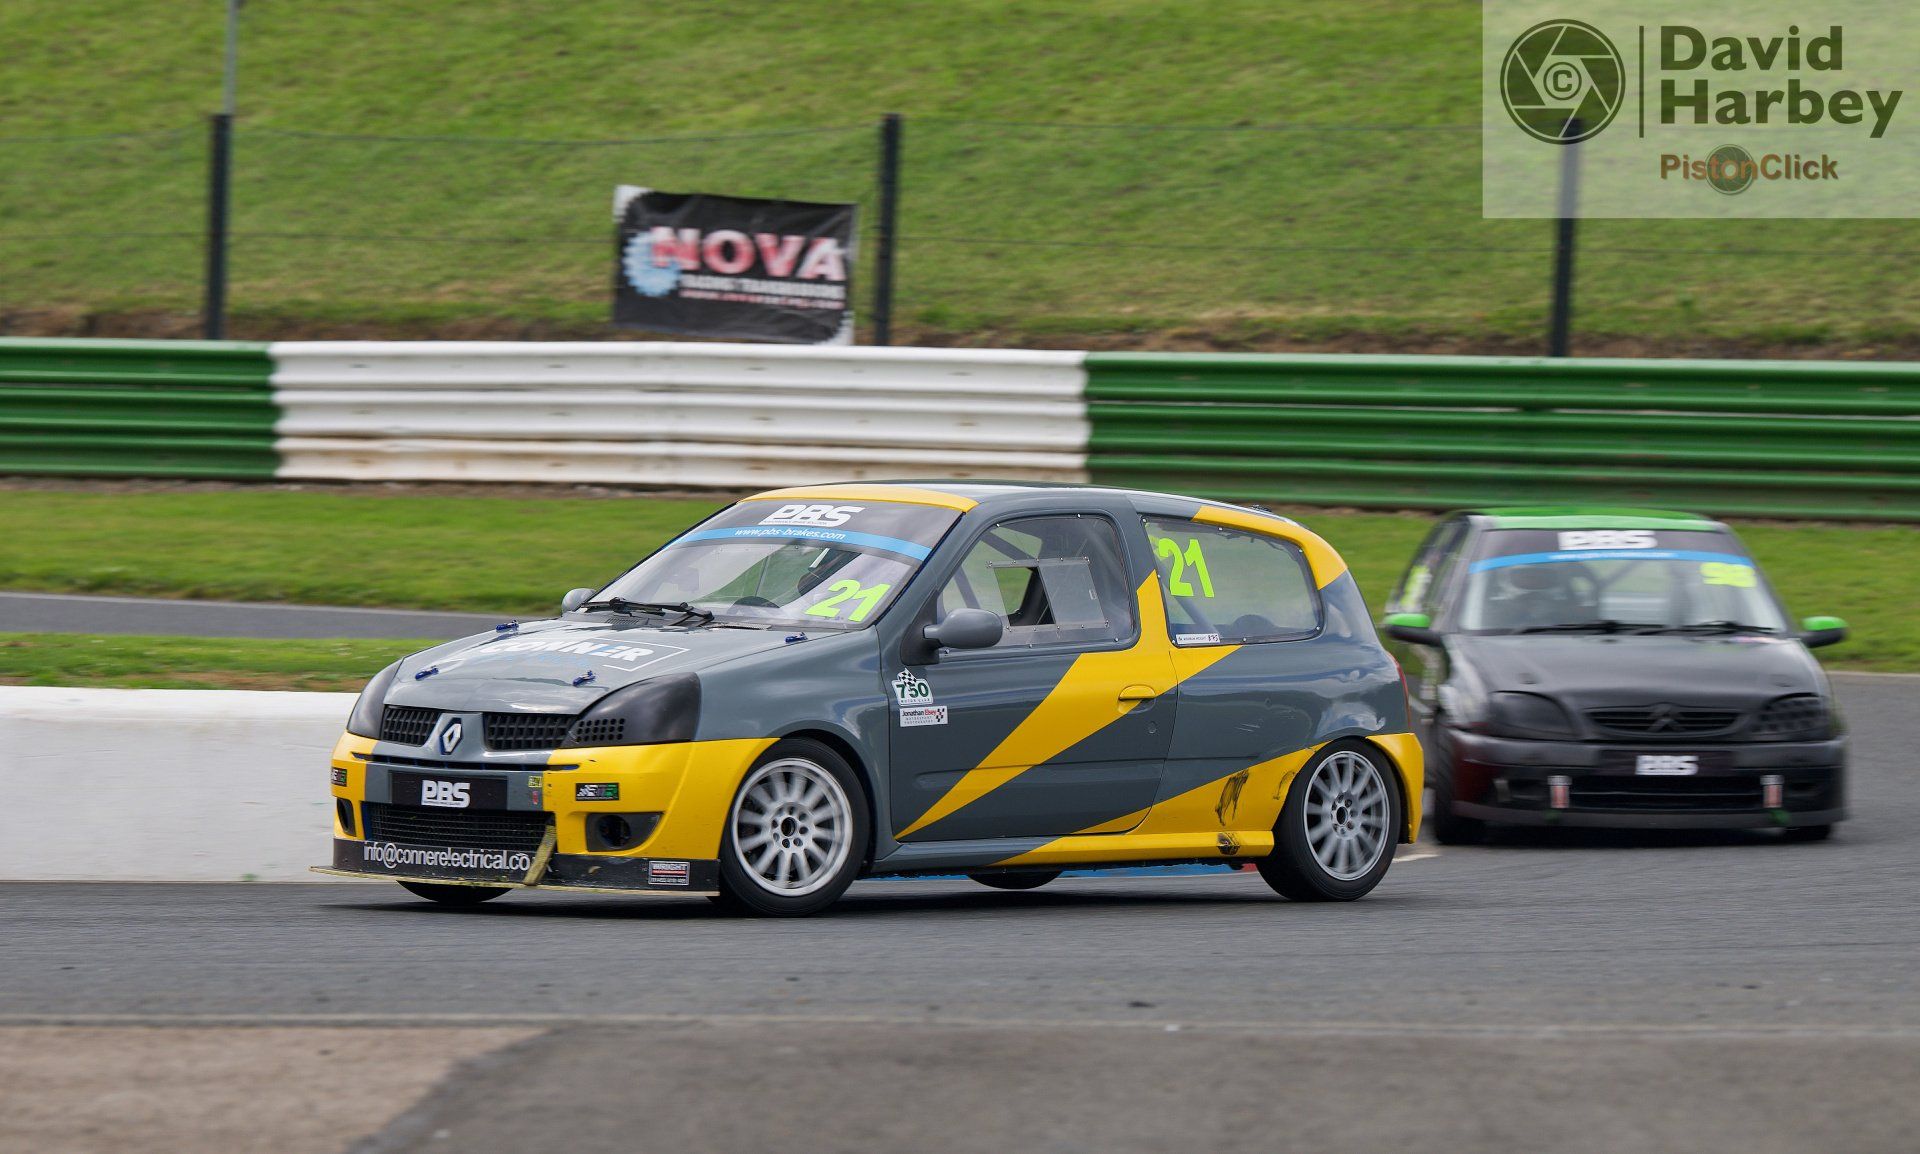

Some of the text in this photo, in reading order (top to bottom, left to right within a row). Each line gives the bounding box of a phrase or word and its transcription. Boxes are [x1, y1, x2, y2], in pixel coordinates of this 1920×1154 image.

[650, 226, 847, 281] NOVA
[758, 504, 866, 528] PBS
[735, 527, 846, 540] www.pbs-brakes.com
[1158, 538, 1215, 598] 21
[804, 579, 892, 622] 21
[896, 681, 929, 698] 750
[421, 780, 471, 808] PBS
[363, 841, 553, 873] info@connerelectrical.co
